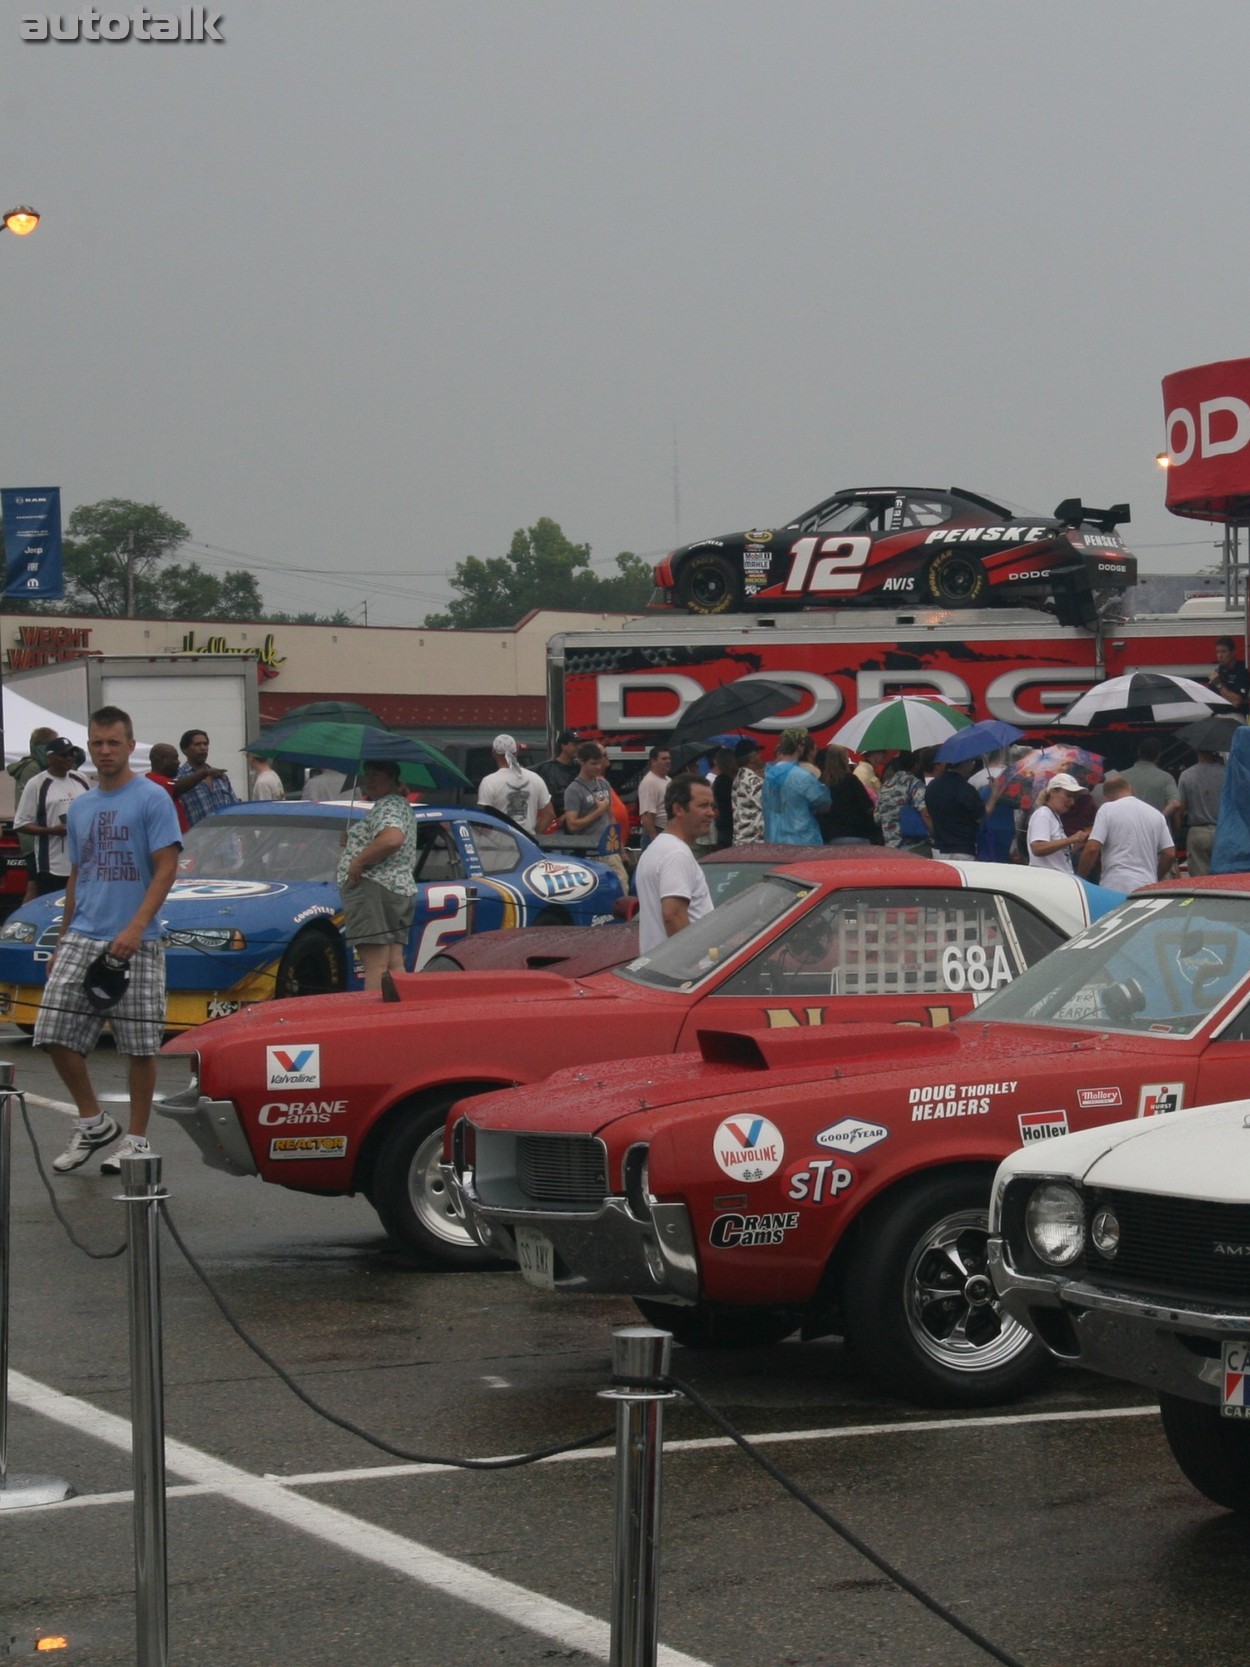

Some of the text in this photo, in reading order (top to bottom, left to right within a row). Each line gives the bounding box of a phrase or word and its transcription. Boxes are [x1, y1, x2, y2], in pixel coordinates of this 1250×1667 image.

[925, 527, 1046, 545] PENSKE
[1084, 535, 1118, 548] PENSKE
[24, 547, 43, 555] Jeep
[784, 536, 872, 592] 12
[1099, 564, 1127, 573] DODGE
[883, 577, 915, 591] AVIS
[19, 626, 93, 649] WEIGHT
[99, 811, 118, 826] SAY
[98, 851, 135, 867] LITTLE
[541, 870, 590, 899] Lite
[414, 886, 467, 972] 2
[942, 945, 1014, 991] 68A
[270, 1074, 316, 1084] Valvoline
[909, 1081, 1018, 1104] DOUG THORLEY
[258, 1100, 349, 1126] CRANE
[911, 1098, 990, 1122] HEADERS
[1150, 1103, 1172, 1111] HURST
[273, 1138, 345, 1152] REACTOR
[720, 1145, 778, 1168] VALVOLINE
[788, 1160, 852, 1202] STP
[710, 1212, 799, 1248] CRANE
